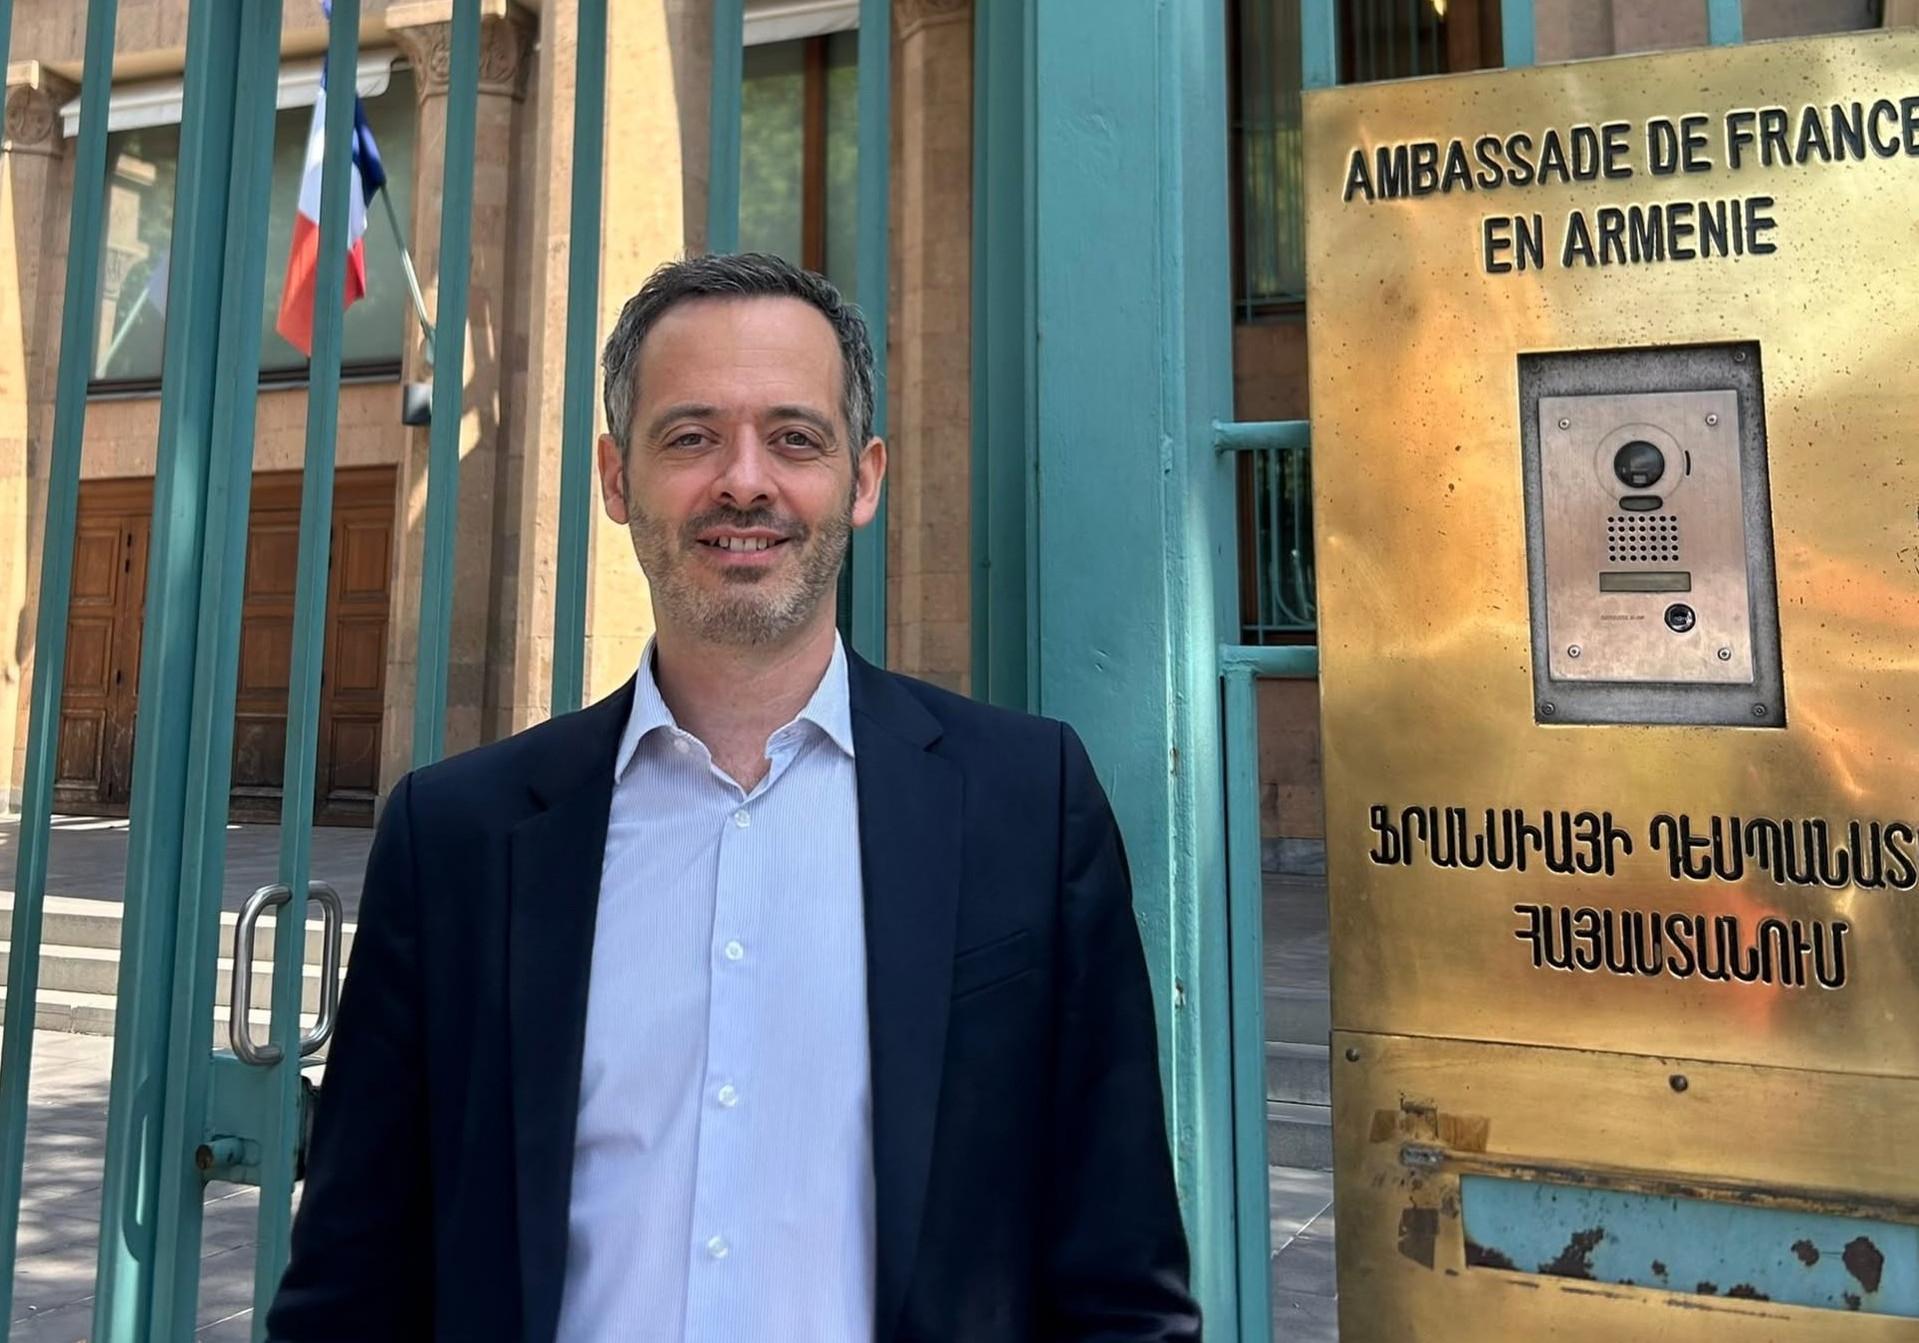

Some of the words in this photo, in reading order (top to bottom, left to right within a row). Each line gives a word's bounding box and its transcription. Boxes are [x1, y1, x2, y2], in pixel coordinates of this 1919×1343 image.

[1343, 122, 1633, 202] AMBASSADE
[1647, 115, 1711, 176] DE
[1725, 96, 1919, 169] FRANCE
[1484, 213, 1543, 273] EN
[1562, 197, 1778, 268] ARMENIE
[1370, 805, 1633, 876] ՖՐԱՆՍԻԱՅԻ
[1650, 814, 1919, 889] ԴԵՍՊԱՆԱՏ
[1514, 905, 1848, 988] ՀԱՅԱՍՏԱՆՈՒՄ
